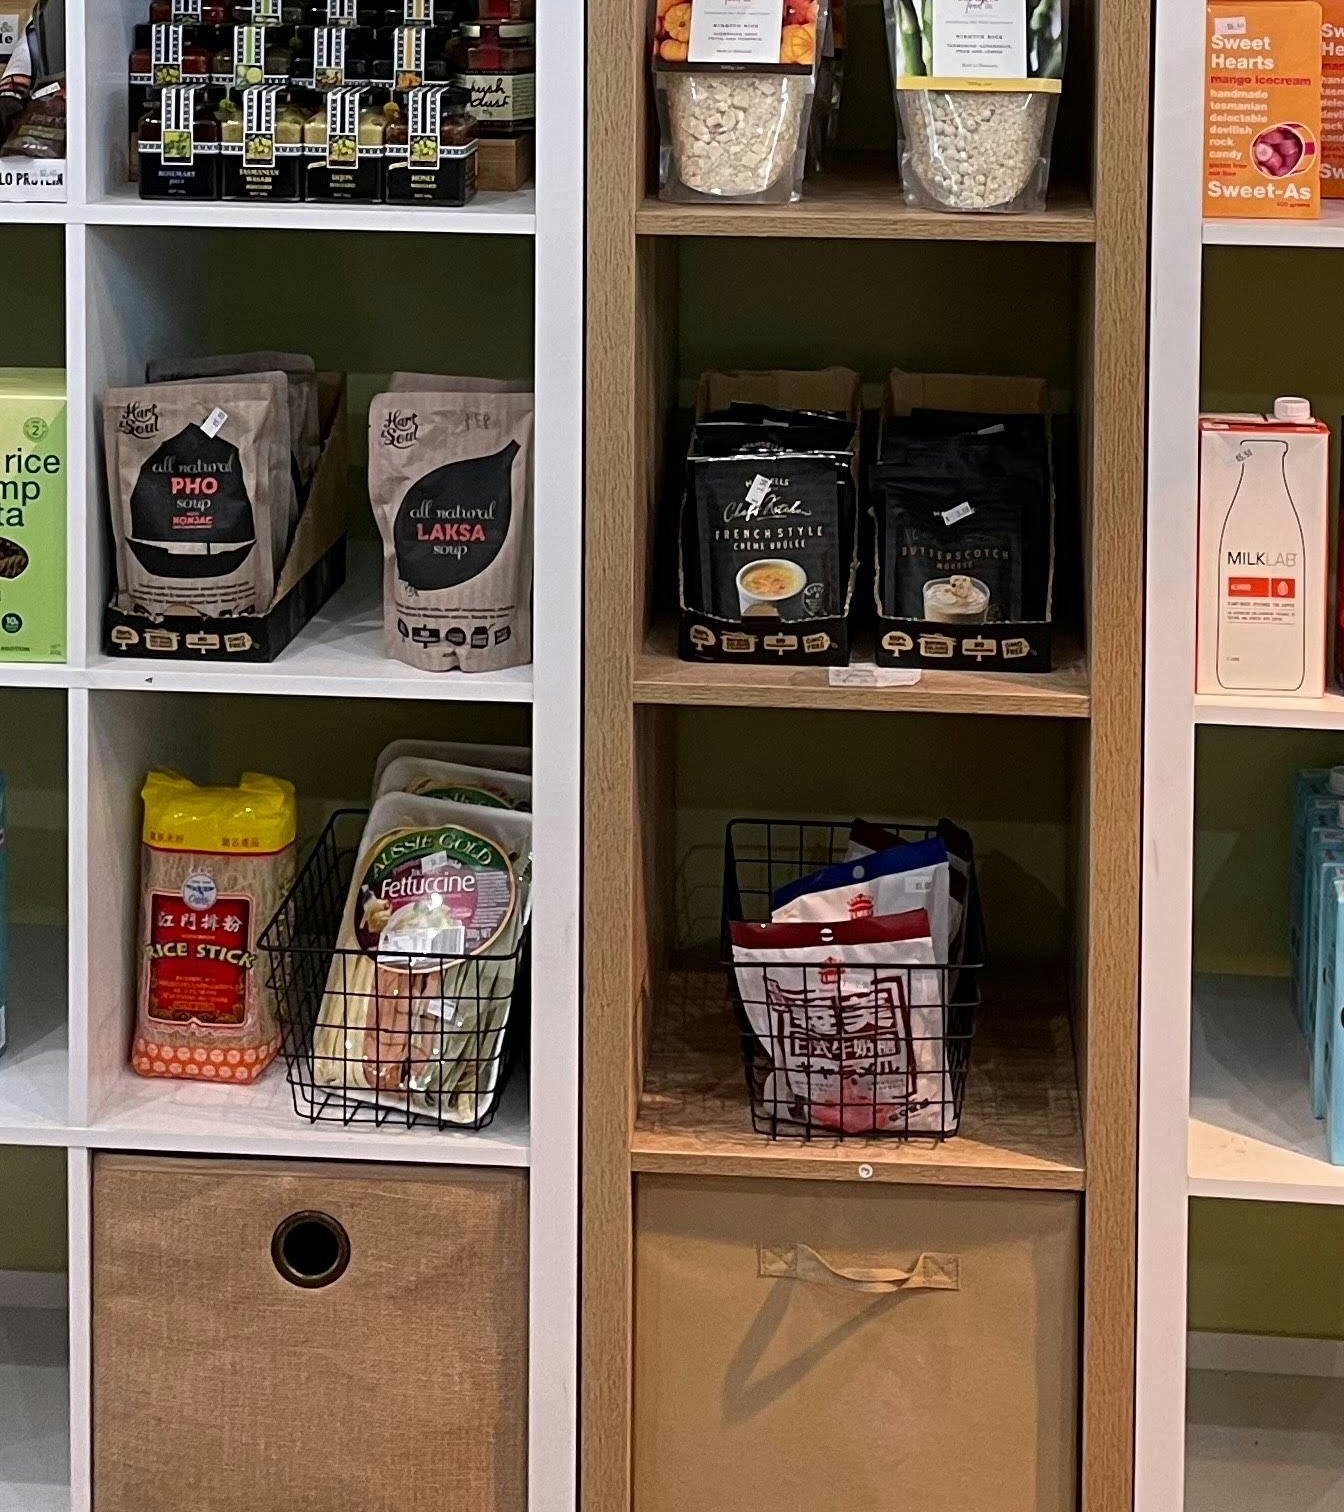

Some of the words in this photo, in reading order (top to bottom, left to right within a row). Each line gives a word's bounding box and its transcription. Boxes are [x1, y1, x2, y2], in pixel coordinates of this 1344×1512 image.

[1212, 36, 1271, 50] Sweet
[1212, 54, 1274, 70] Hearts
[1211, 76, 1251, 86] mango
[1256, 76, 1311, 85] icecream
[1211, 89, 1268, 99] handmade
[1210, 126, 1252, 135] devilish
[1209, 138, 1233, 146] rock
[1209, 150, 1242, 161] candy
[1208, 181, 1311, 200] Sweet-As
[6, 448, 60, 473] rice
[152, 456, 175, 473] all
[179, 455, 233, 473] natural
[171, 478, 218, 495] PHO
[176, 498, 211, 509] soup
[410, 500, 432, 519] all
[436, 501, 496, 519] natural
[416, 523, 485, 541] LAKSA
[716, 528, 770, 539] FRENCH
[778, 526, 823, 538] STYLE
[433, 544, 467, 559] soup
[1228, 552, 1296, 567] MILKLAB
[440, 834, 492, 865] GOLD
[382, 872, 474, 898] Fettuccine
[145, 943, 187, 960] RICE
[197, 944, 256, 968] STICK
